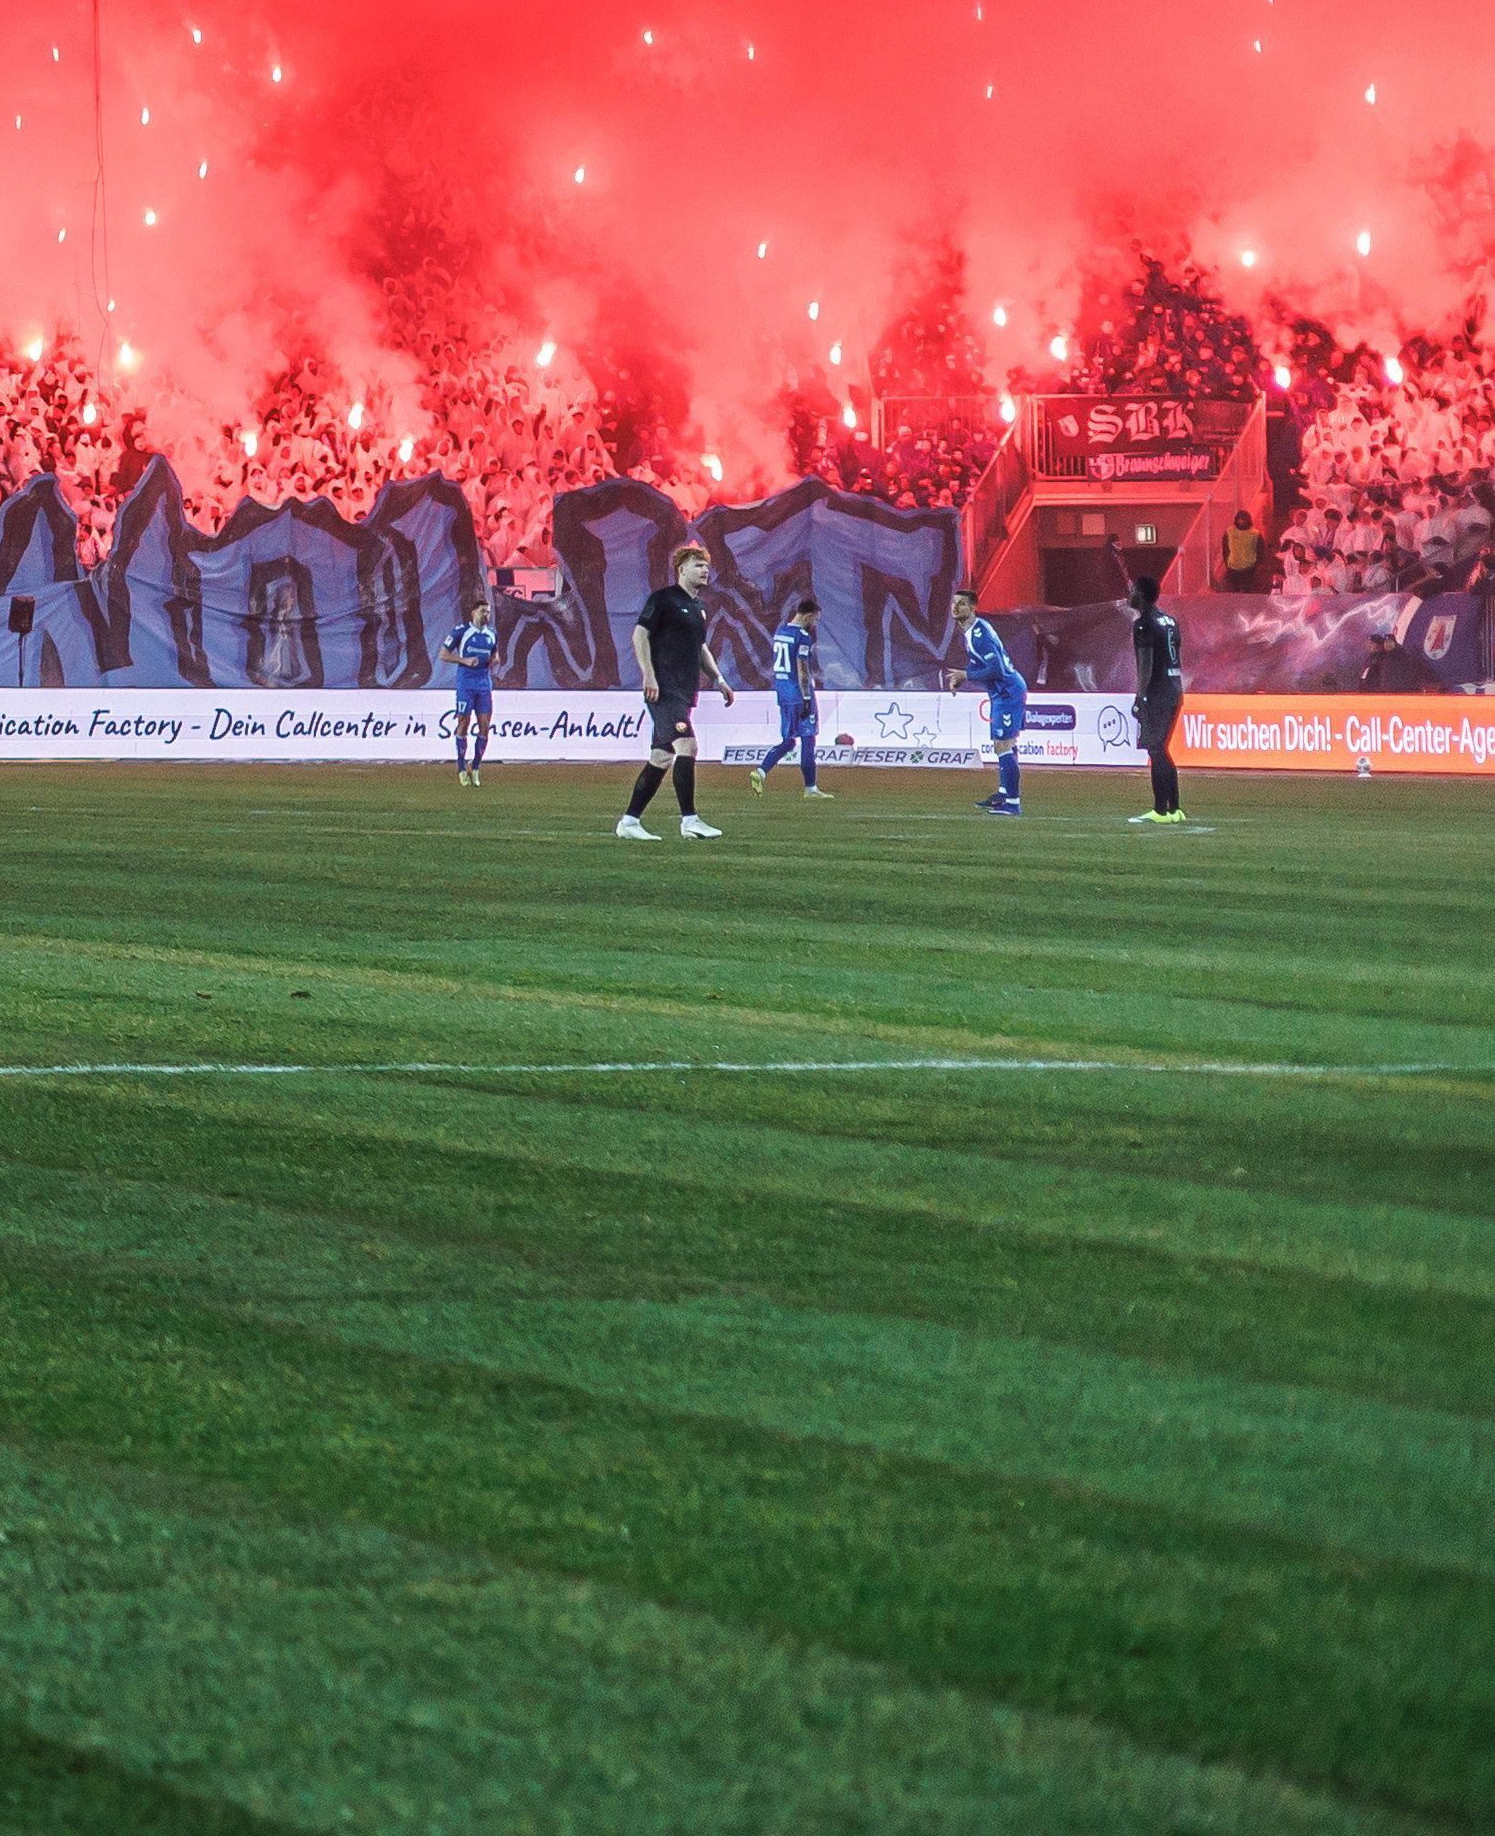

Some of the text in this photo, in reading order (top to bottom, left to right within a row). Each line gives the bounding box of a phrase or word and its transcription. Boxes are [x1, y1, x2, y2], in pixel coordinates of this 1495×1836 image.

[1086, 400, 1195, 445] SBK
[773, 641, 791, 673] 21
[89, 709, 184, 745] Factory
[209, 707, 266, 741] Dein
[275, 709, 396, 740] Callcenter
[404, 714, 427, 738] in
[438, 709, 646, 740] Scsen-Anhalt!
[1025, 710, 1074, 728] Dialogexperten
[1183, 714, 1214, 750] Wir
[1216, 715, 1281, 752] suchen
[1284, 715, 1333, 753] Dich!
[723, 749, 852, 762] FESE RAF
[854, 750, 975, 765] FESER GRAF
[981, 739, 1079, 761] cocation factory
